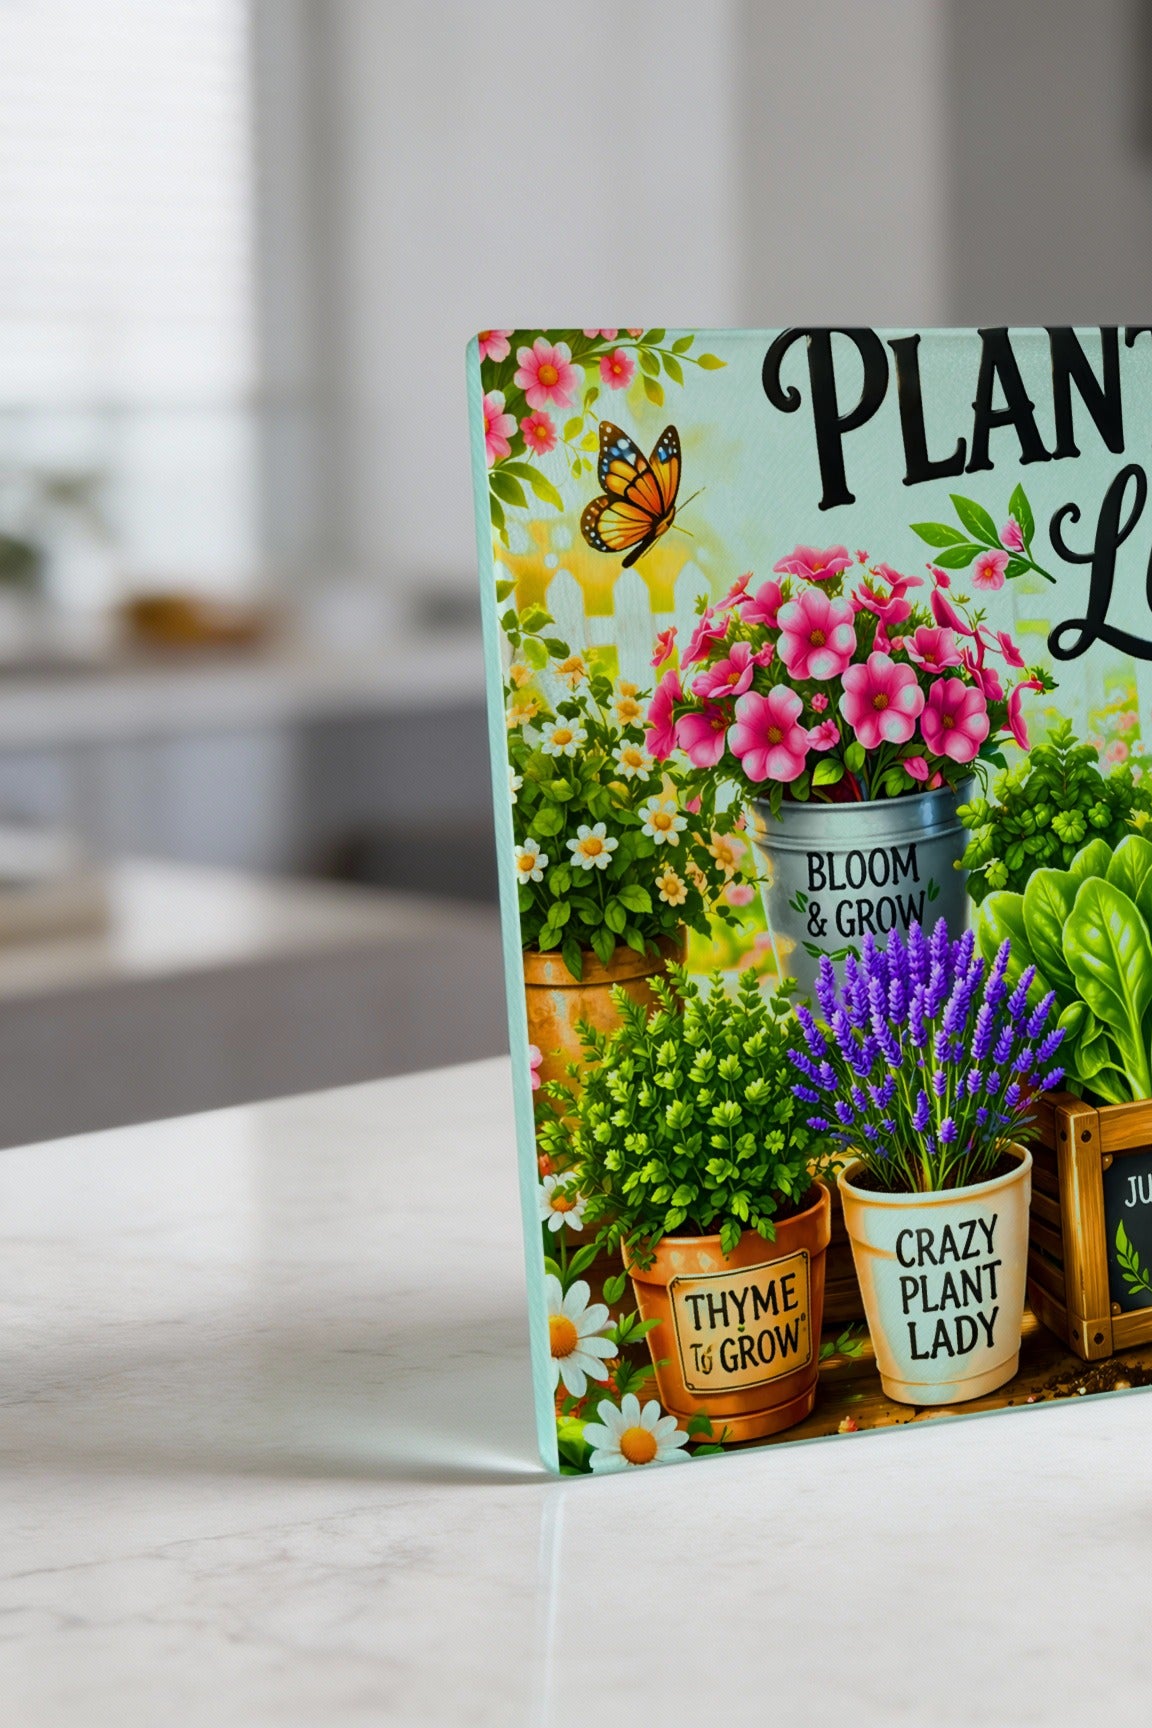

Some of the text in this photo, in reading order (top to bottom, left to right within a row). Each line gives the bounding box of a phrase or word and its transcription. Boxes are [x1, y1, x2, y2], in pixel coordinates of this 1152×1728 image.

[806, 842, 921, 892] BLOOM
[806, 890, 926, 938] & GROW
[895, 1213, 999, 1269] CRAZY
[684, 1272, 800, 1332] THYME
[899, 1259, 1003, 1315] PLANT
[719, 1316, 801, 1374] GROW
[906, 1306, 1000, 1361] LADY
